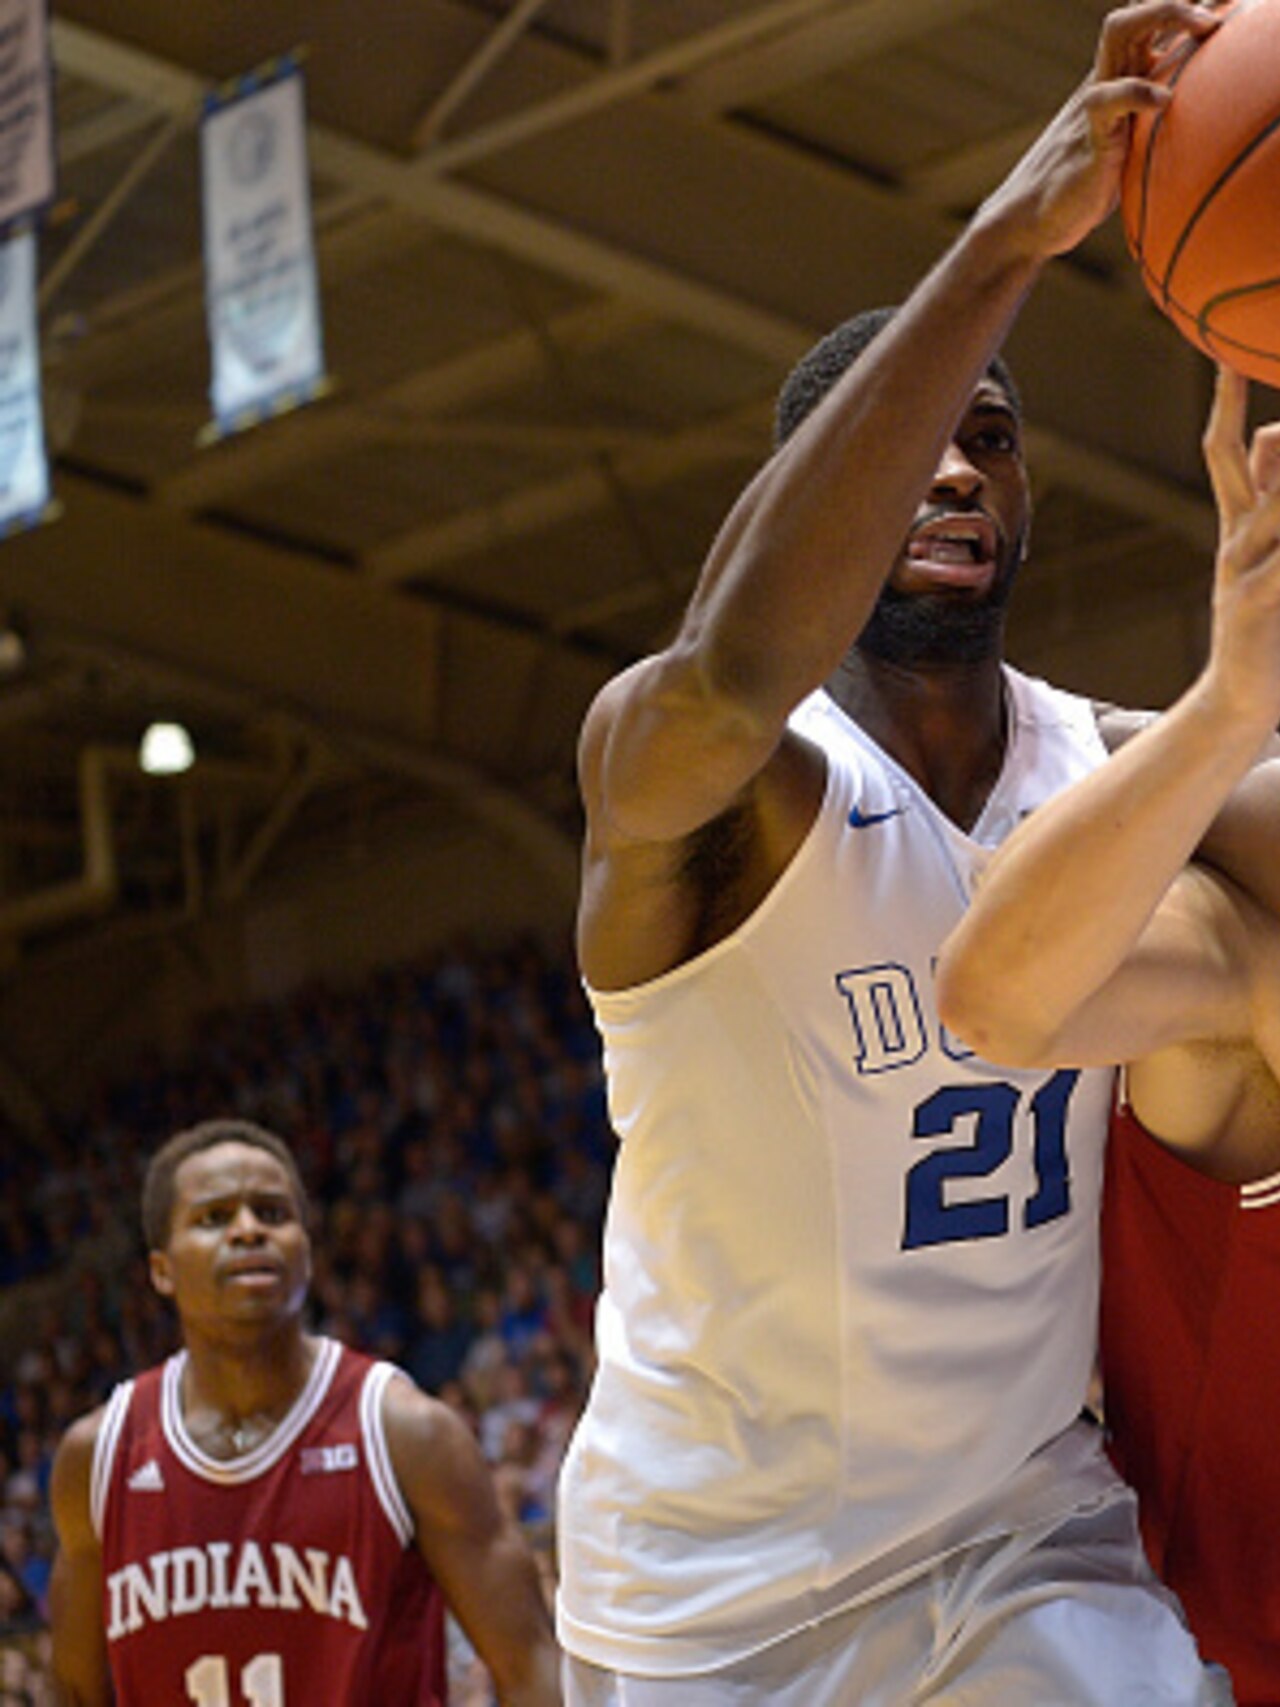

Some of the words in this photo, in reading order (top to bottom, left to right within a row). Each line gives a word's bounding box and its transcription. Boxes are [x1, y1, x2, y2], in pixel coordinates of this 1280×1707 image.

[900, 1068, 1082, 1251] 21
[107, 1541, 369, 1642] INDIANA
[185, 1653, 285, 1707] 11
